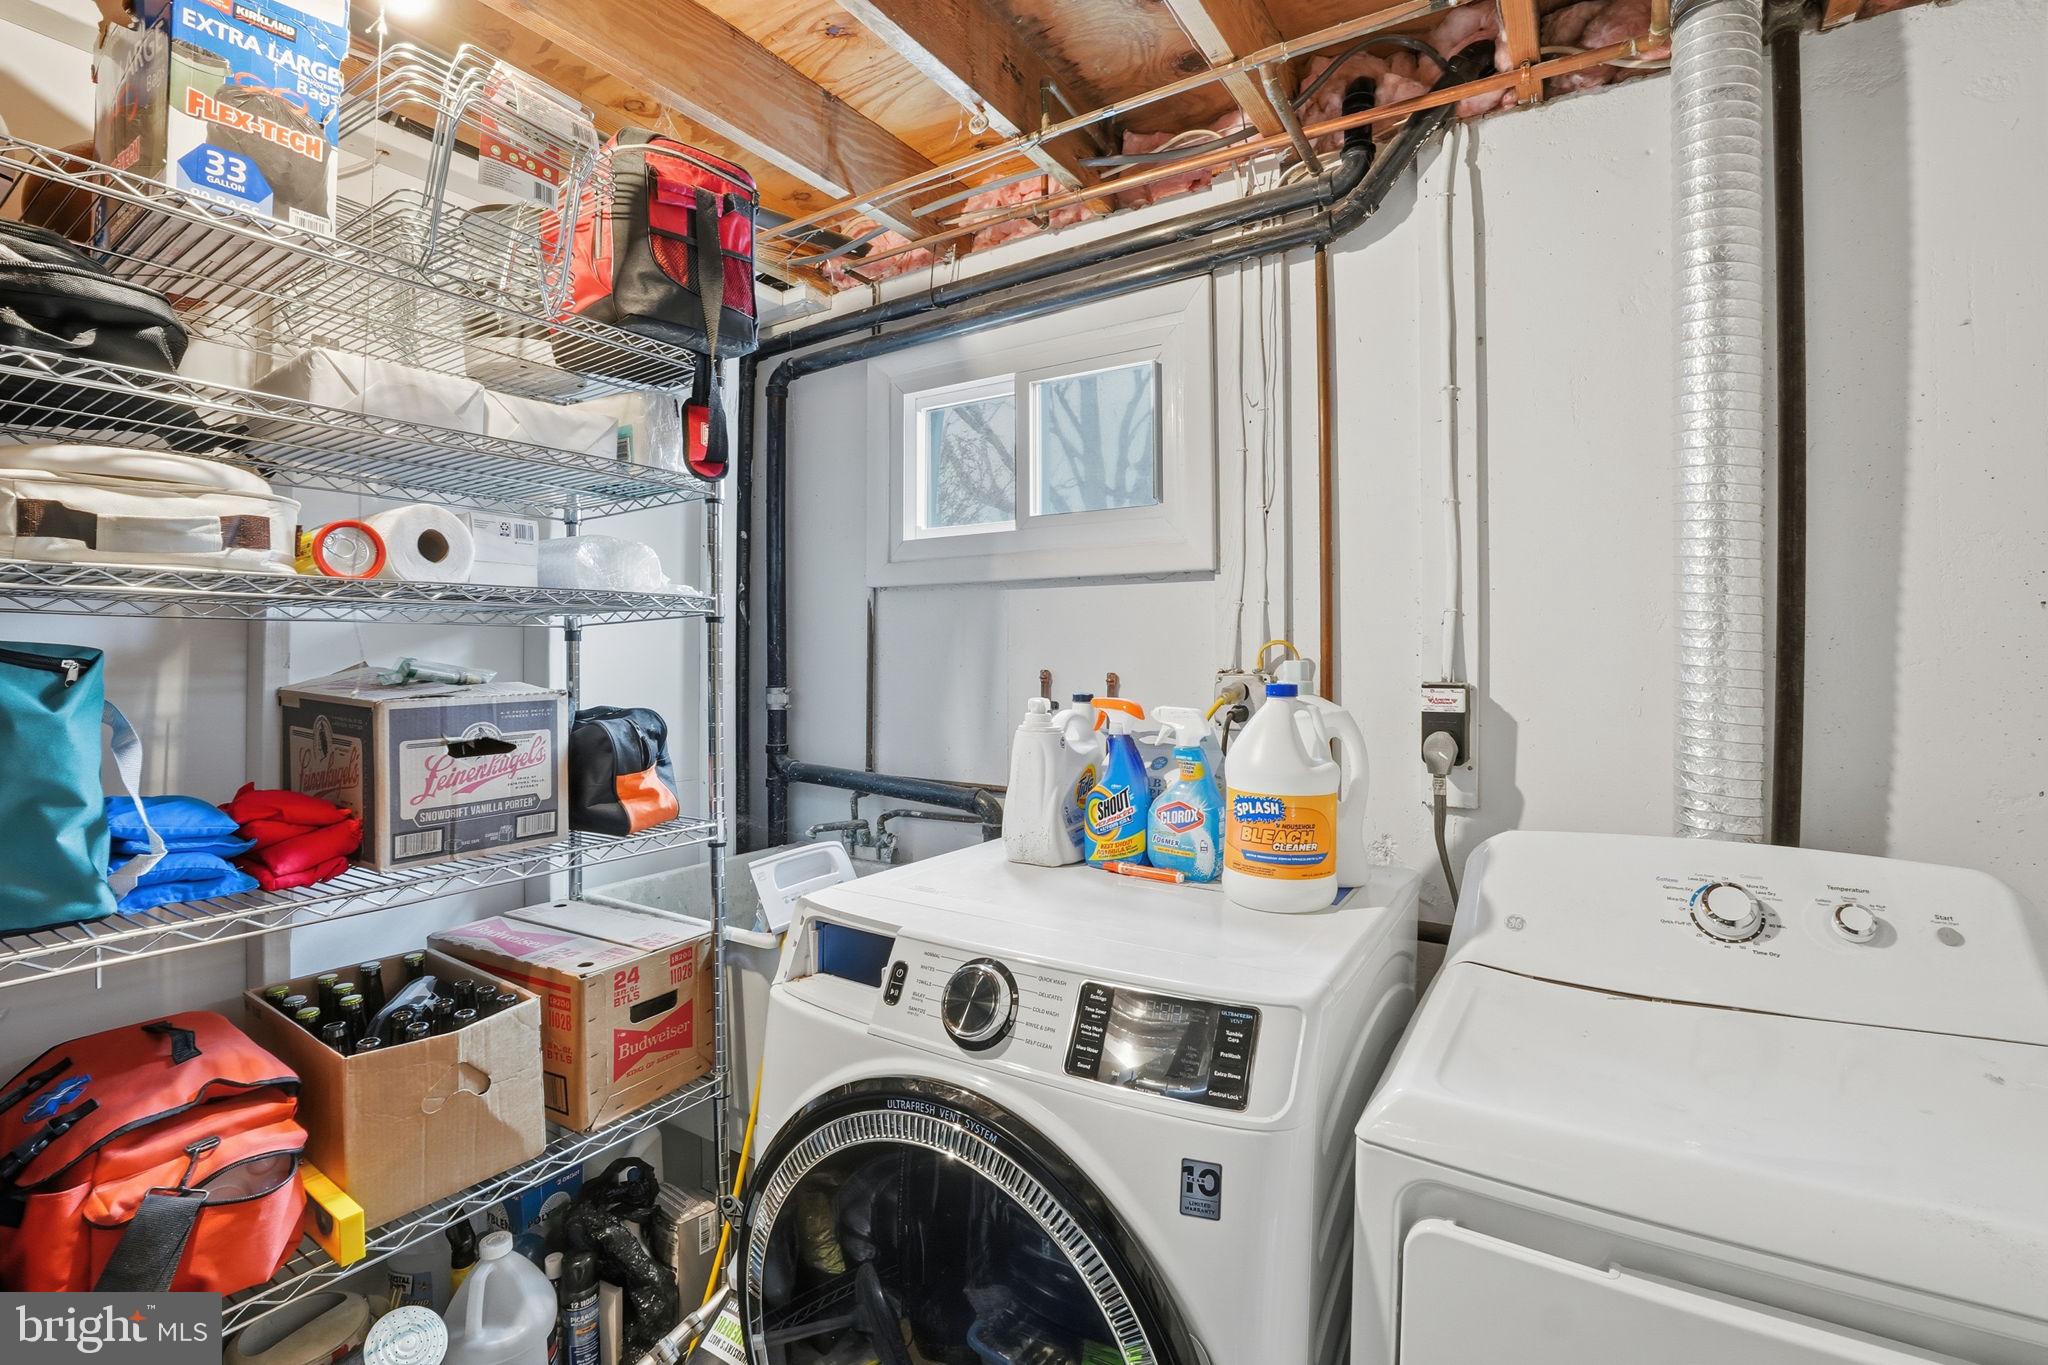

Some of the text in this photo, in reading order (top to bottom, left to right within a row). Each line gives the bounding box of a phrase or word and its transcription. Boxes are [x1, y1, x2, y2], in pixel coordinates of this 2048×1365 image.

[236, 5, 296, 36] KIRKLAND
[182, 8, 262, 56] EXTRA
[266, 41, 342, 85] LARGE
[297, 80, 342, 106] Bags
[186, 86, 324, 162] FLEX-TECH
[205, 150, 247, 183] 33
[206, 175, 246, 193] GALLON
[410, 735, 546, 806] Leinenkugel's
[419, 806, 468, 823] SNOWDRIFT
[470, 802, 503, 816] VANILLA
[1097, 788, 1130, 820] SHOUT
[1160, 808, 1200, 826] CLOROX
[1236, 802, 1280, 816] SPLASH
[1240, 825, 1315, 845] BLEACH
[1272, 843, 1318, 852] CLEANER
[1826, 884, 1870, 894] Temperature
[614, 965, 640, 991] 24
[671, 962, 693, 985] 11028
[613, 991, 640, 1008] BTLS
[618, 1021, 691, 1061] Budweiser
[887, 1099, 999, 1144] ULTRAFRESH VENT SYSTEM
[1182, 1165, 1220, 1197] 10
